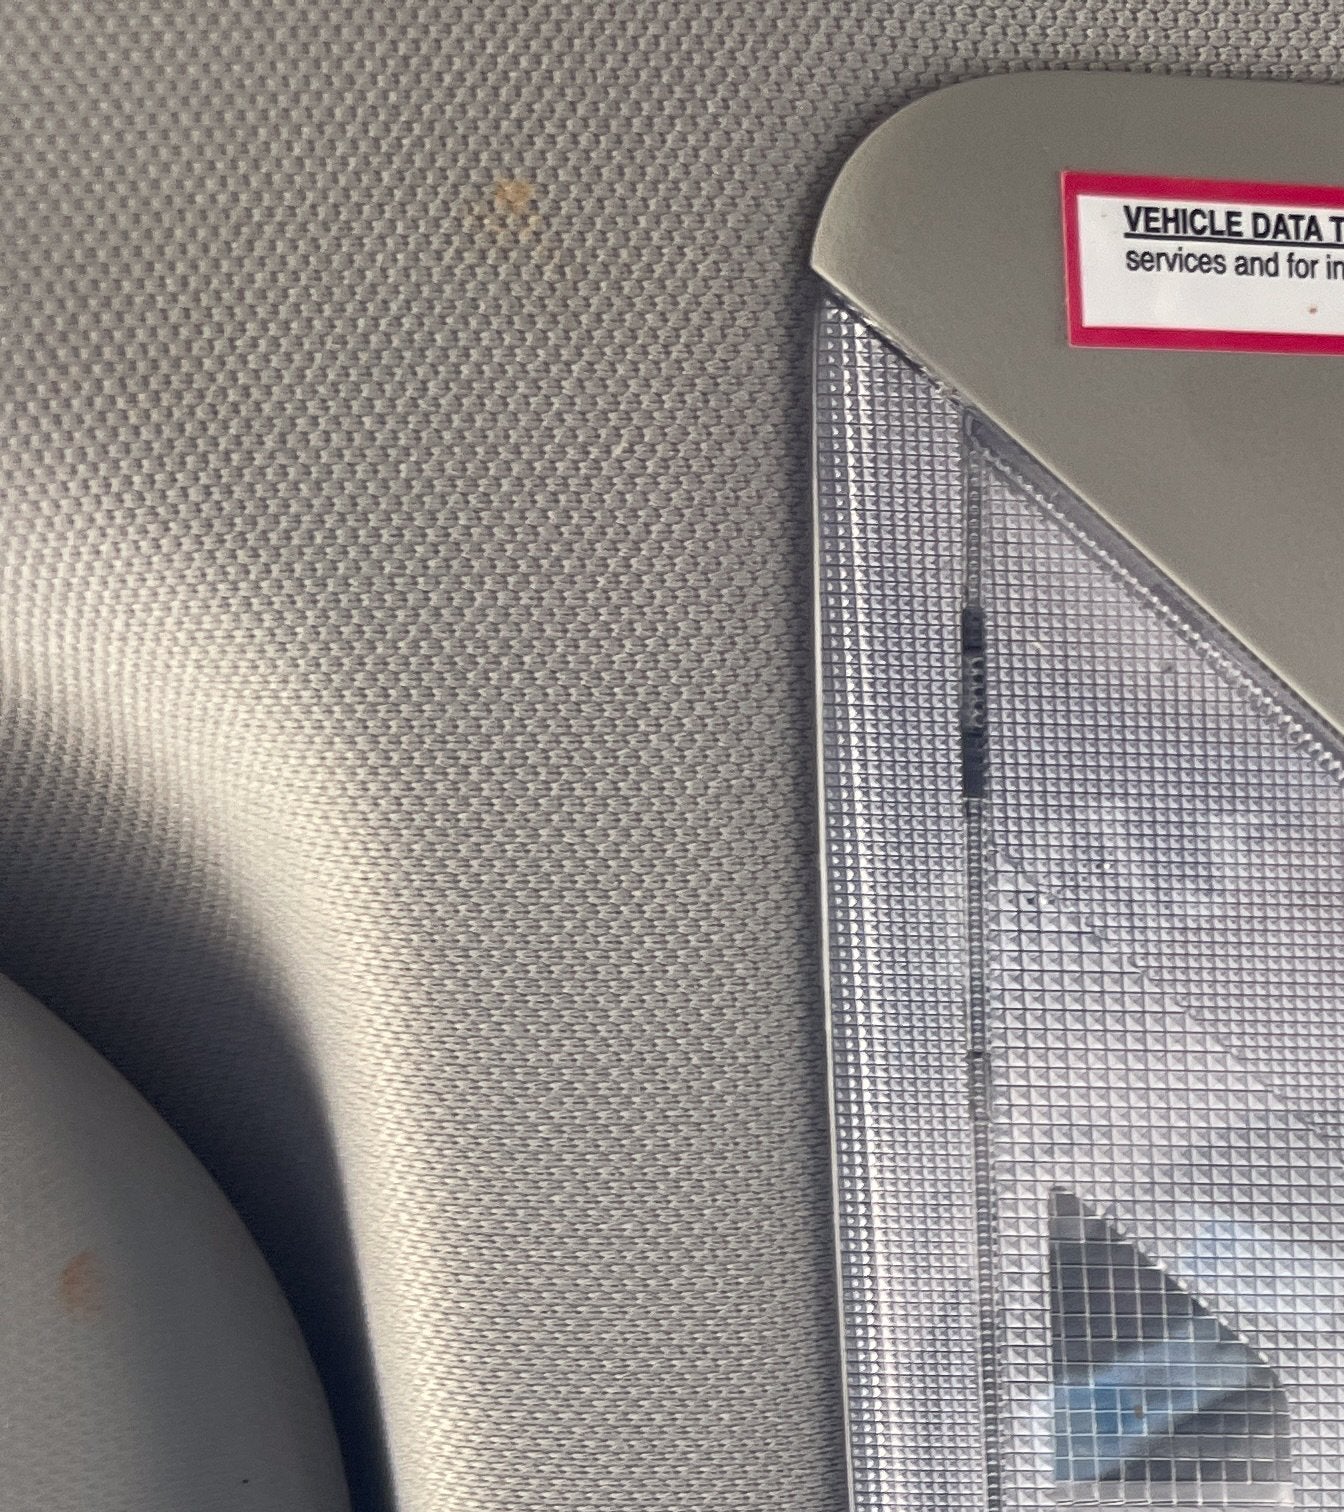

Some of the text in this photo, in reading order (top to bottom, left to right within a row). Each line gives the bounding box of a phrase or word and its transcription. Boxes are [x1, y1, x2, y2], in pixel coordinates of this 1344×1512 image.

[1124, 206, 1243, 235] VEHICLE
[1252, 213, 1323, 241] DATA
[1126, 248, 1227, 275] services
[1234, 251, 1279, 278] and
[1286, 252, 1319, 279] for
